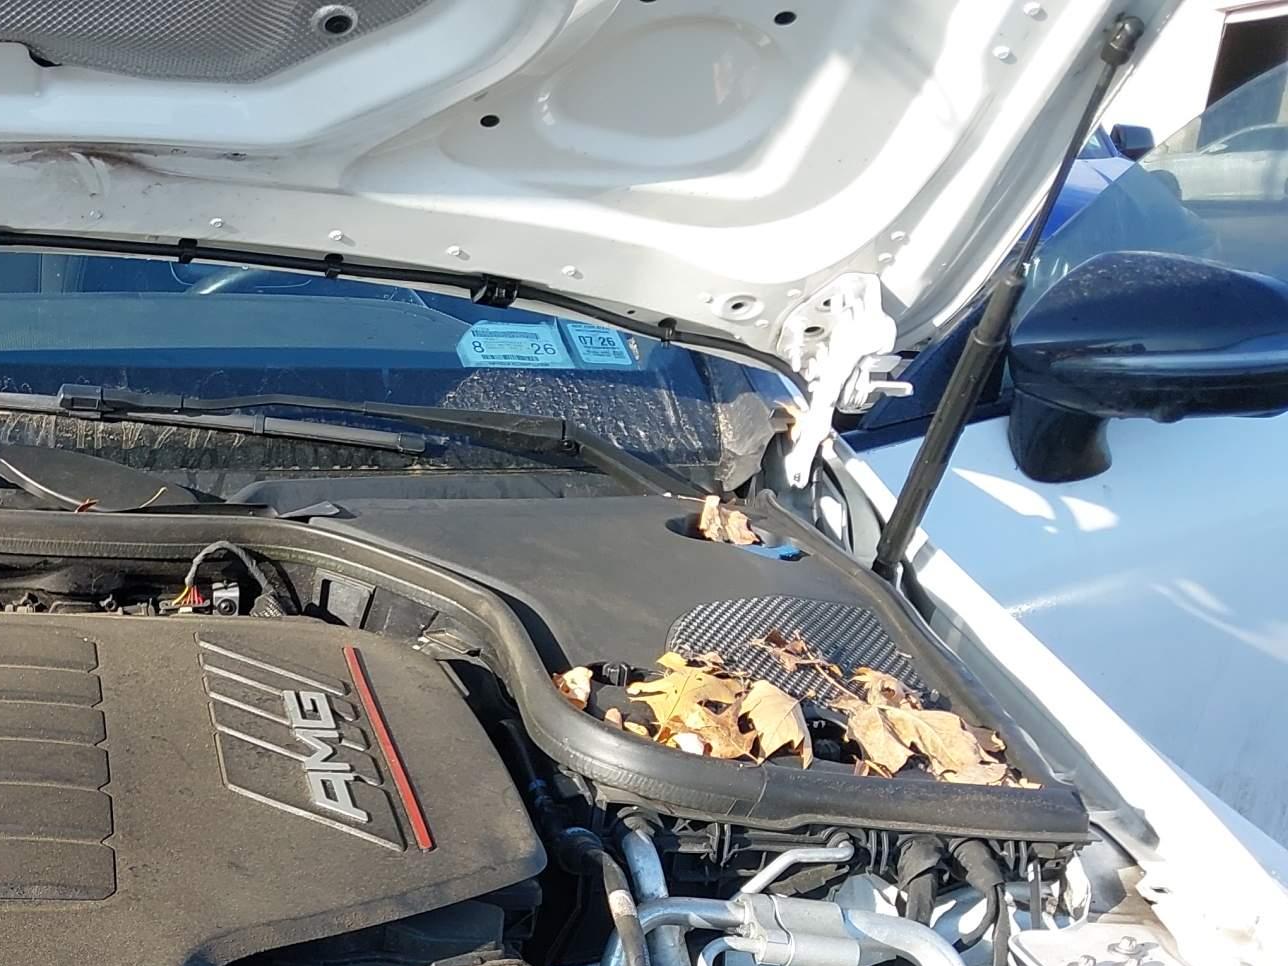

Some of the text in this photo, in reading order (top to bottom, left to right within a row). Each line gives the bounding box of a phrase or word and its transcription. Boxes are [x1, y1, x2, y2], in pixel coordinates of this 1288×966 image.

[471, 340, 485, 353] 8
[530, 342, 556, 355] 26
[577, 335, 616, 347] 07 26
[281, 689, 369, 823] AMG
